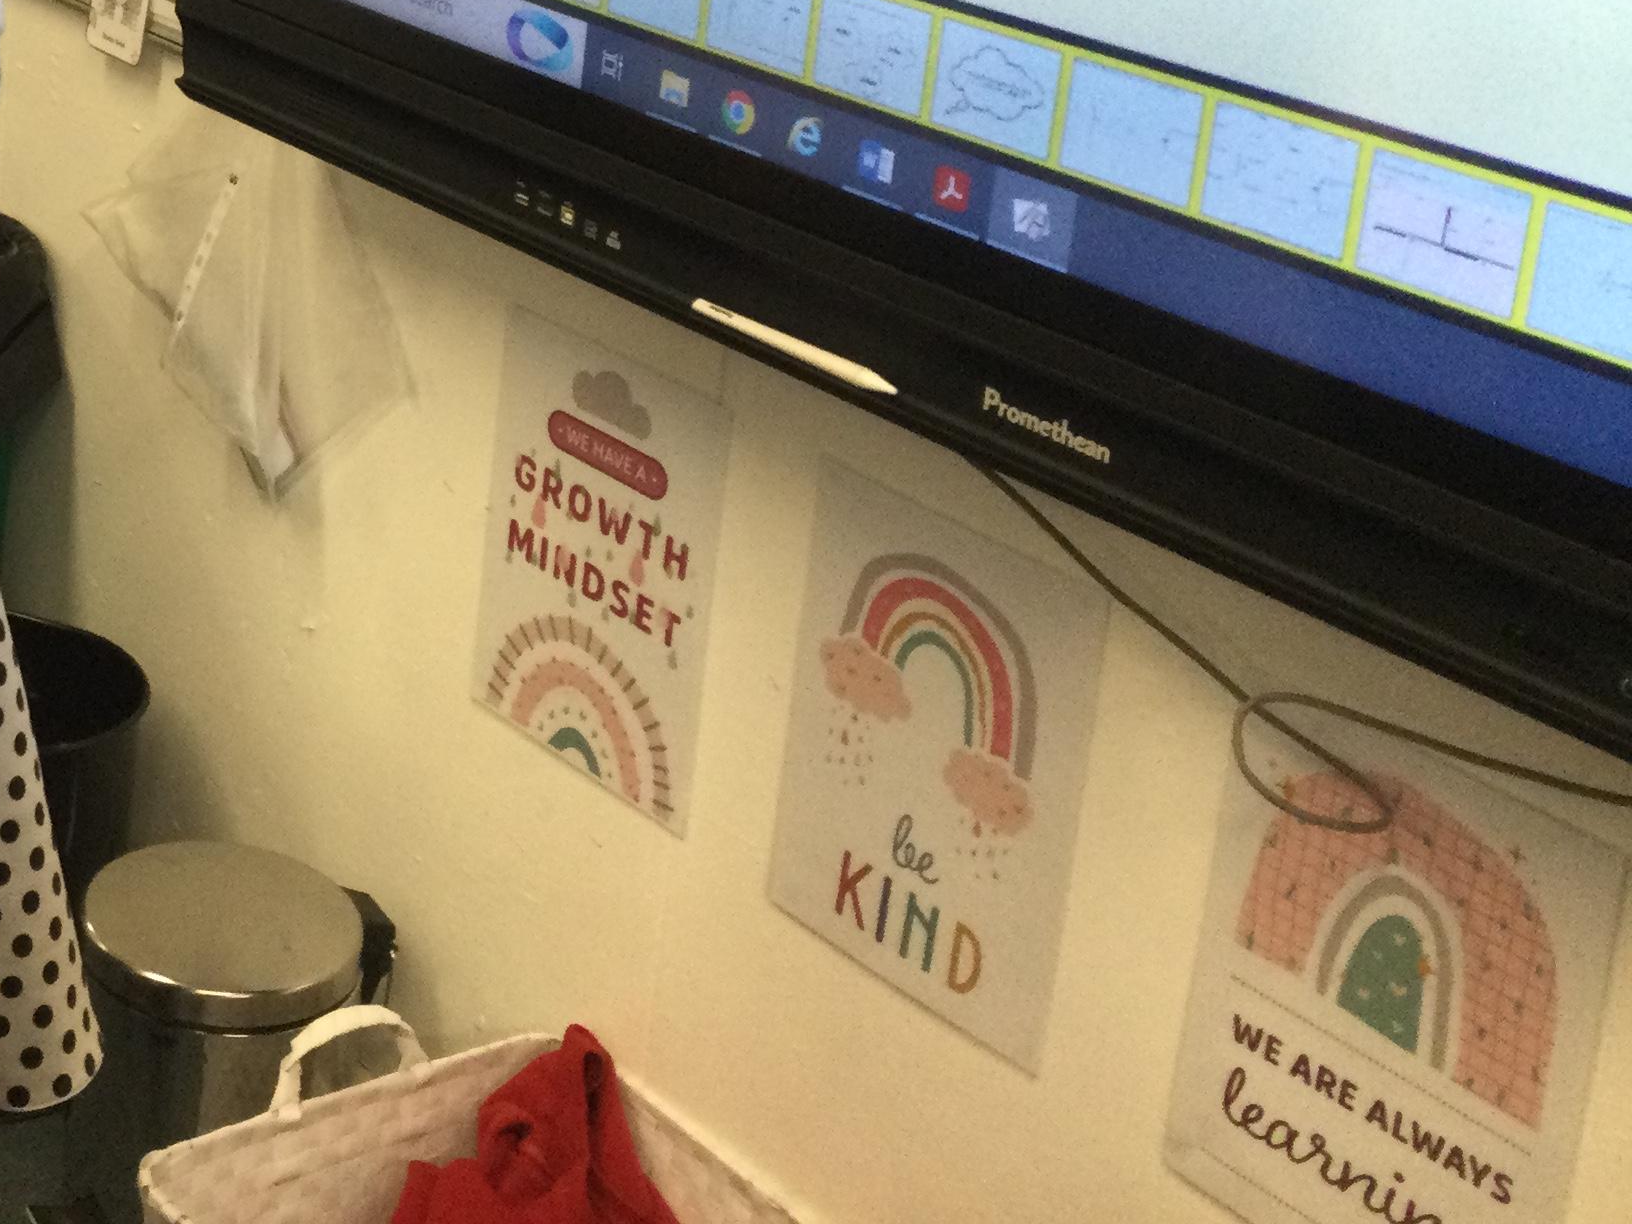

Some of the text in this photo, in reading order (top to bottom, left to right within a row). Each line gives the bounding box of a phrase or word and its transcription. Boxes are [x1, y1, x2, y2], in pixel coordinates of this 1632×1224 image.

[566, 425, 647, 484] WE HAVE A
[981, 385, 1111, 464] Promethean
[514, 454, 690, 582] GROWTH
[506, 517, 683, 648] MINDSET
[892, 813, 940, 885] be
[834, 849, 983, 995] KIND
[1231, 1013, 1515, 1206] WE ARE ALWAYS
